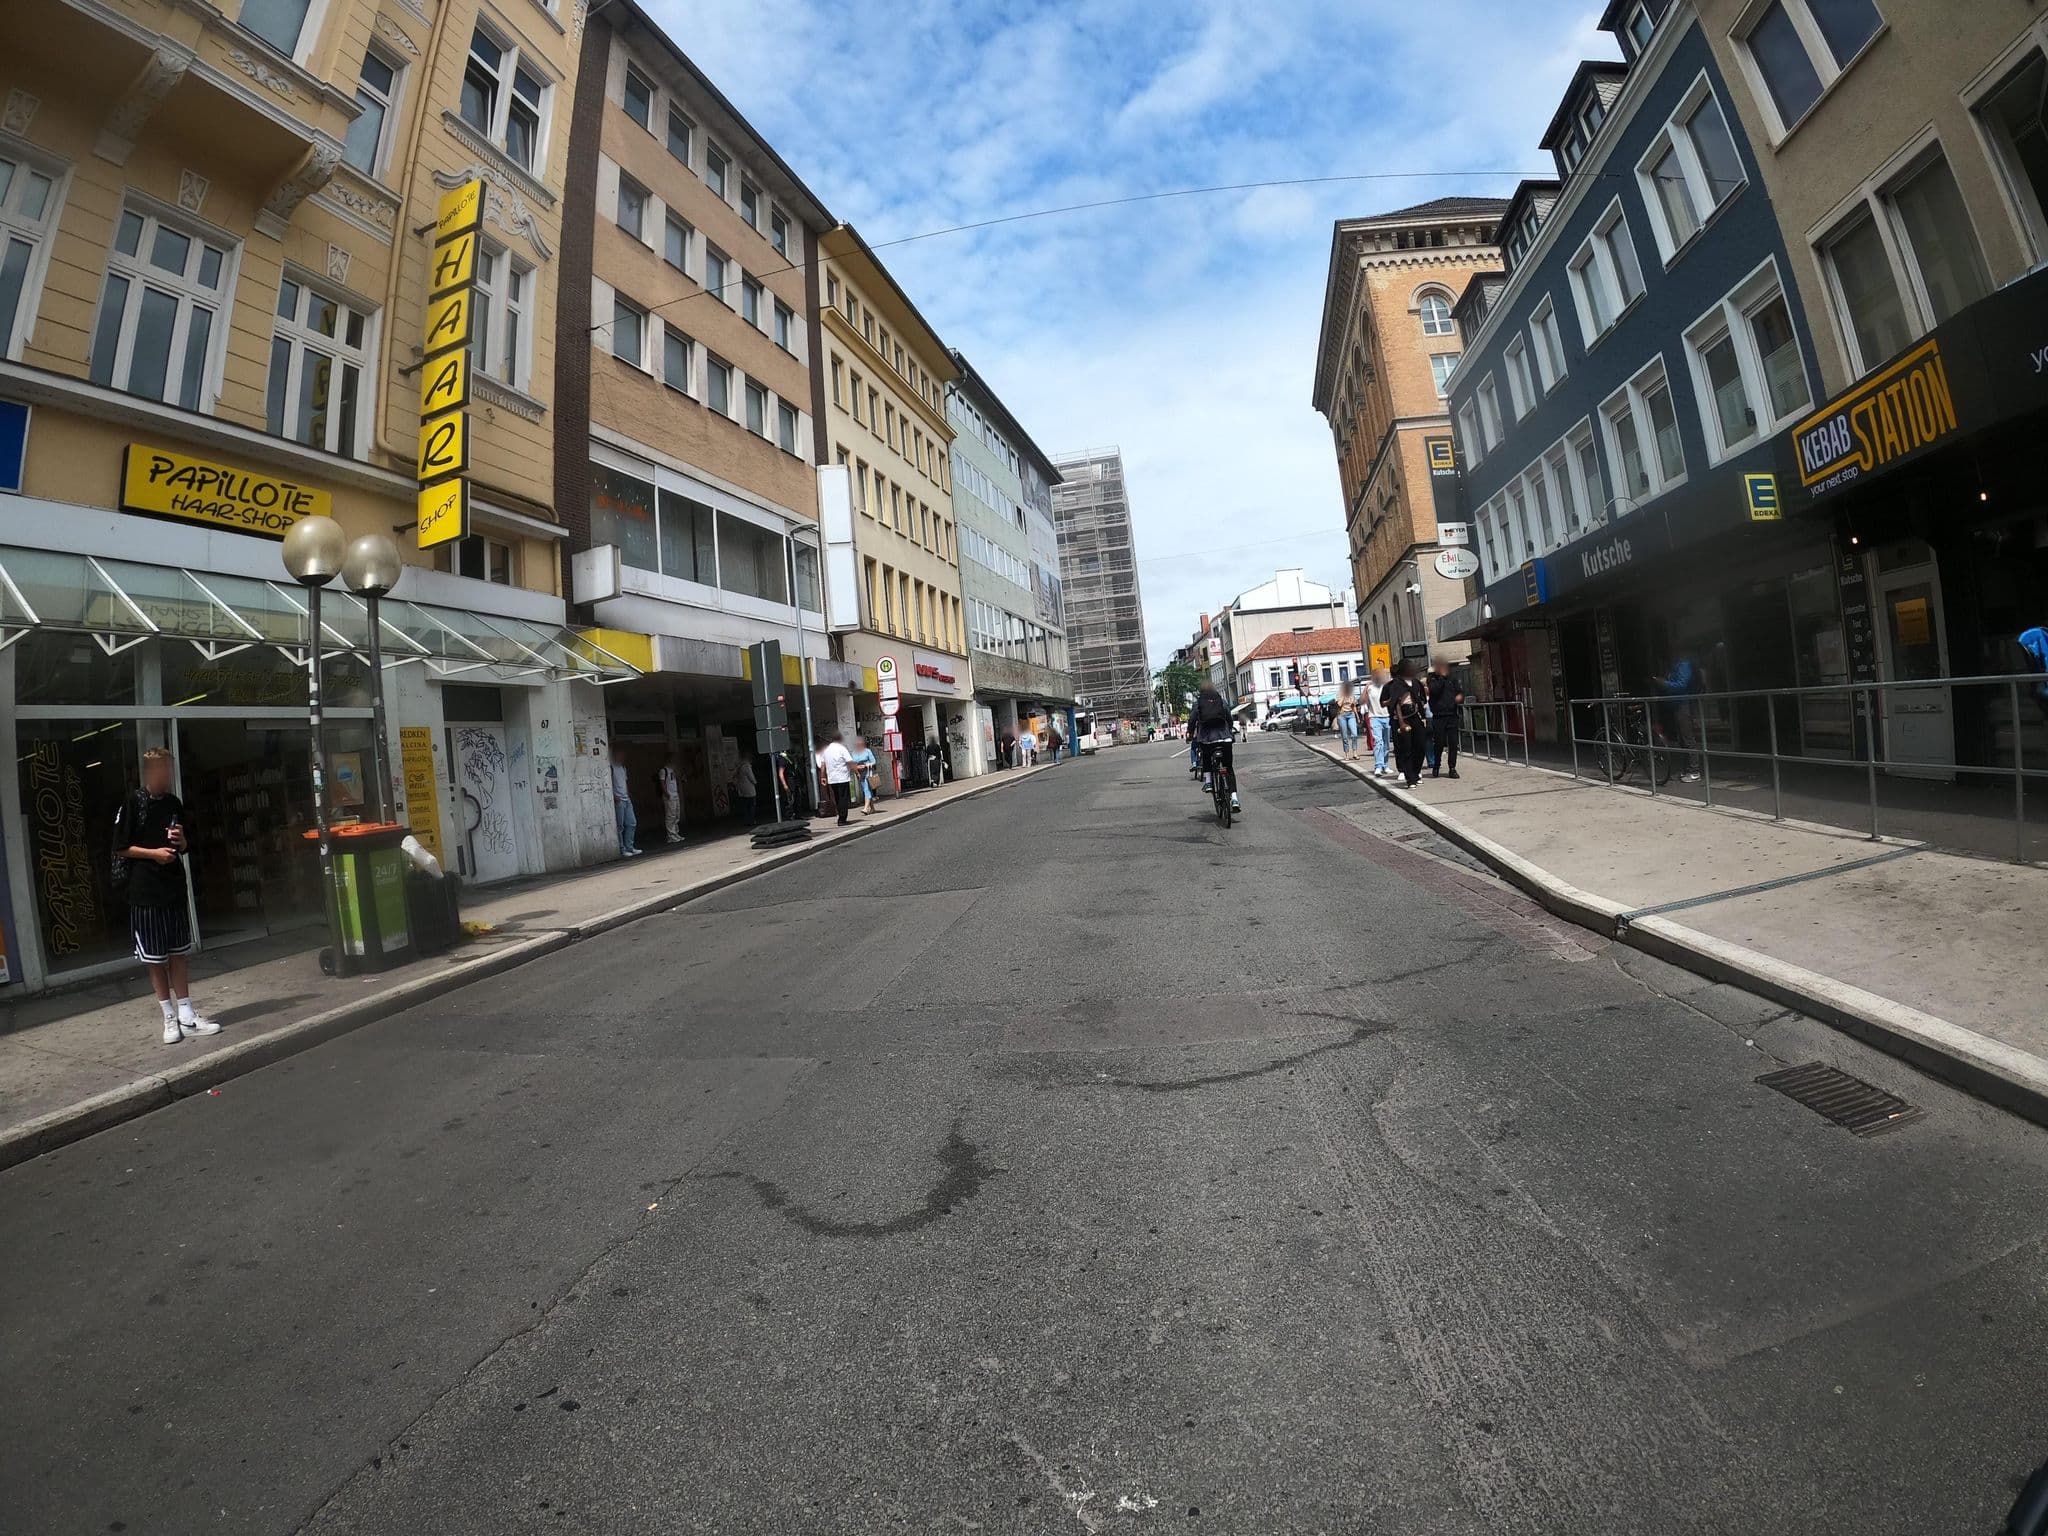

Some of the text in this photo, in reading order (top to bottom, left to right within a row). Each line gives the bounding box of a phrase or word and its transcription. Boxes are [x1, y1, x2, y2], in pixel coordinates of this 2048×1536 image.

[1801, 355, 1958, 473] KEBAB STATION
[1810, 465, 1859, 498] your next stop
[171, 493, 295, 530] HAAR-SHOP
[420, 494, 457, 534] SHOP
[1581, 536, 1632, 578] Kutsche
[540, 719, 549, 729] 67
